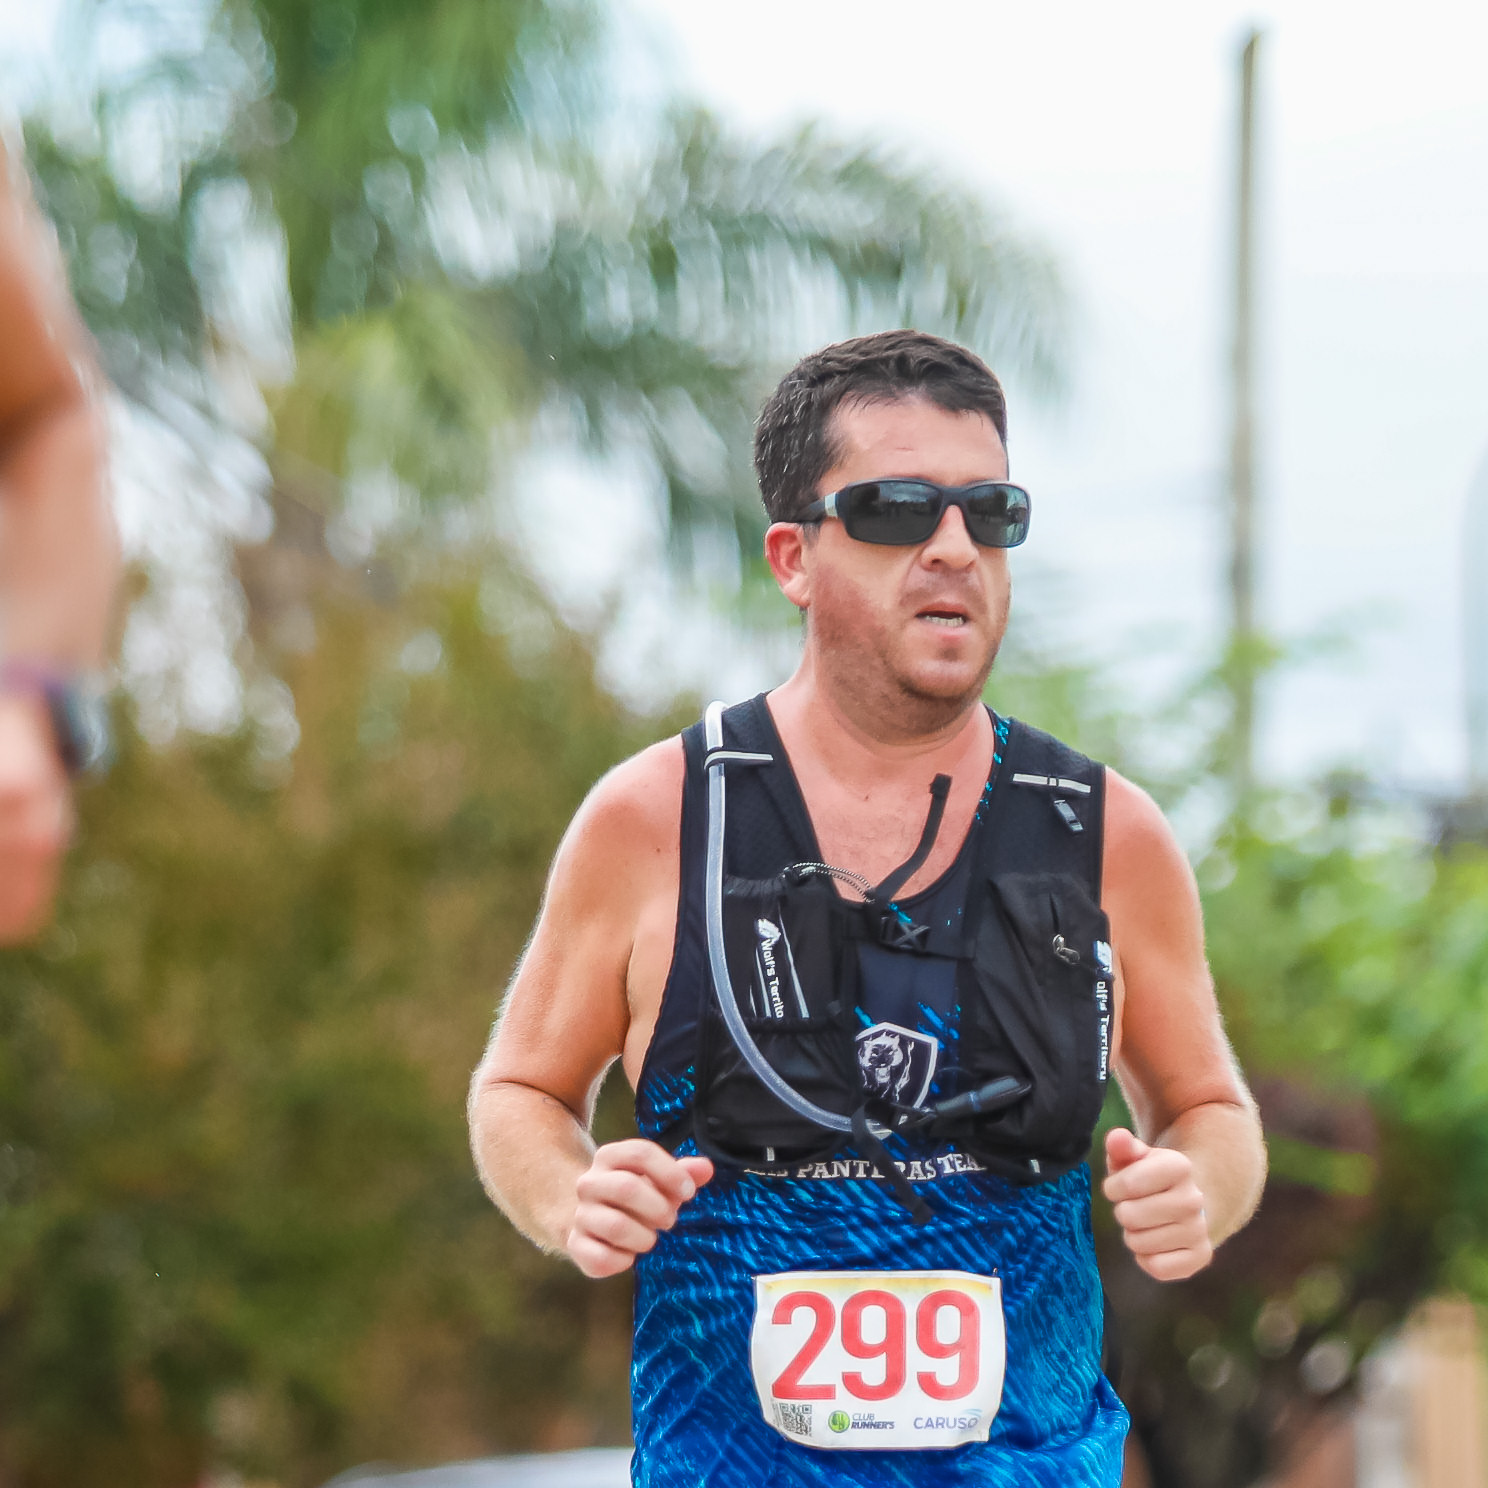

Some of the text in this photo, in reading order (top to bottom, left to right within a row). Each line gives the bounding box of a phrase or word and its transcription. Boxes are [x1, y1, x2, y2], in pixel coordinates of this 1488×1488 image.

[1096, 981, 1108, 1011] olf's
[937, 1153, 987, 1174] TEA
[772, 1290, 980, 1400] 299
[850, 1420, 895, 1430] RUNNER'S
[852, 1412, 875, 1421] CLUB
[913, 1416, 979, 1430] CARUSO
